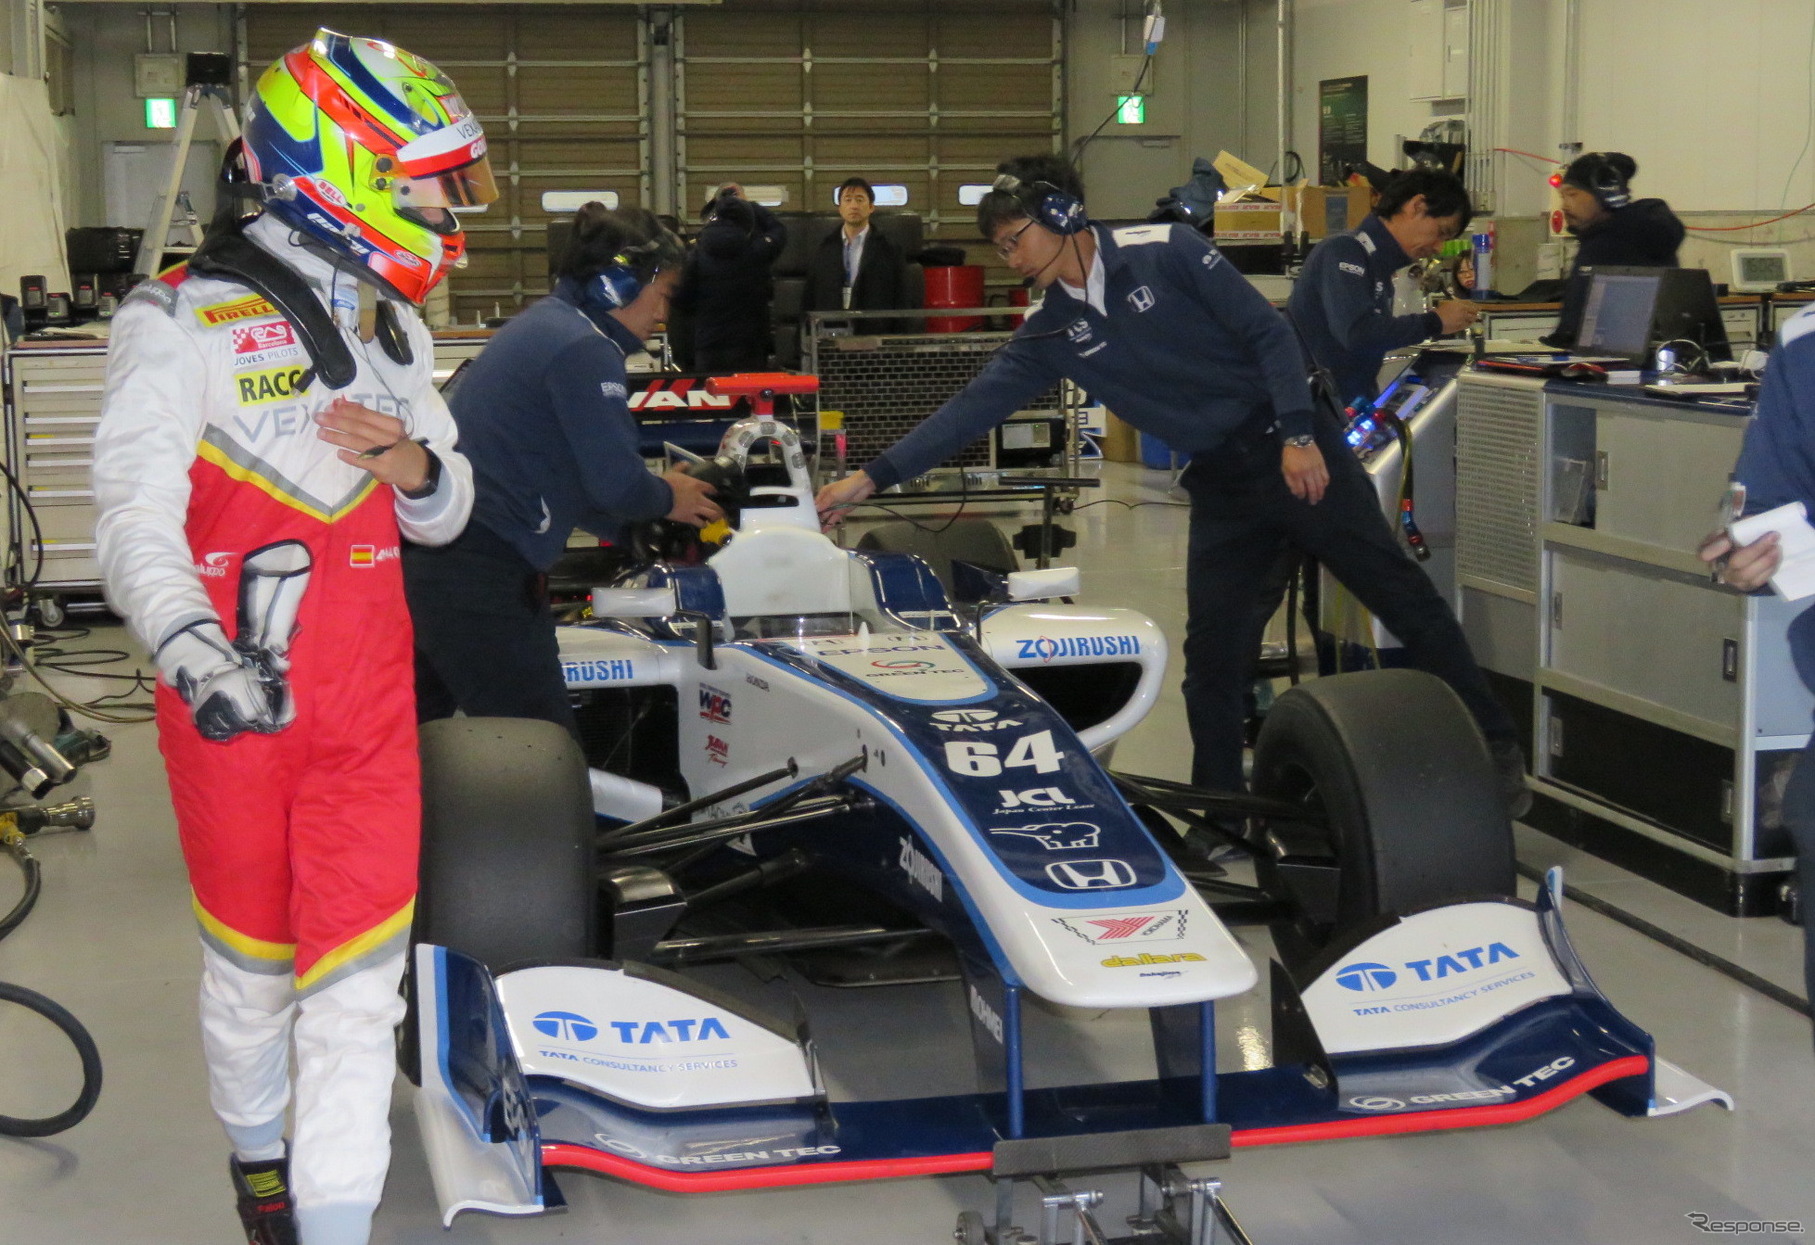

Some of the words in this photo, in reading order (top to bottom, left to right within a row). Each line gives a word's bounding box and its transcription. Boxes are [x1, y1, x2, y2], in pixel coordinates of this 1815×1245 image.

[318, 181, 343, 203] BELL
[1339, 262, 1366, 276] EPSON
[203, 297, 279, 324] PIRELL
[234, 353, 265, 366] JOVES
[267, 347, 299, 360] PILOTS
[818, 644, 946, 656] EPSON
[1015, 635, 1140, 659] ZOJIRUSHI
[929, 719, 1024, 733] TATA
[944, 729, 1065, 778] 64
[998, 786, 1076, 808] JCL
[1100, 952, 1208, 968] dallara
[1404, 942, 1521, 982] TATA
[1353, 1006, 1391, 1016] TATA
[1393, 990, 1478, 1013] CONSULTANCY
[1480, 971, 1536, 993] SERVICES
[610, 1017, 731, 1044] TATA
[538, 1050, 578, 1061] TATA
[583, 1056, 674, 1073] CONSULTANCY
[679, 1059, 738, 1071] SERVICES
[1410, 1085, 1517, 1104] GREEN
[1513, 1056, 1576, 1087] TEC
[655, 1150, 770, 1165] GREEN
[772, 1145, 842, 1158] TEC
